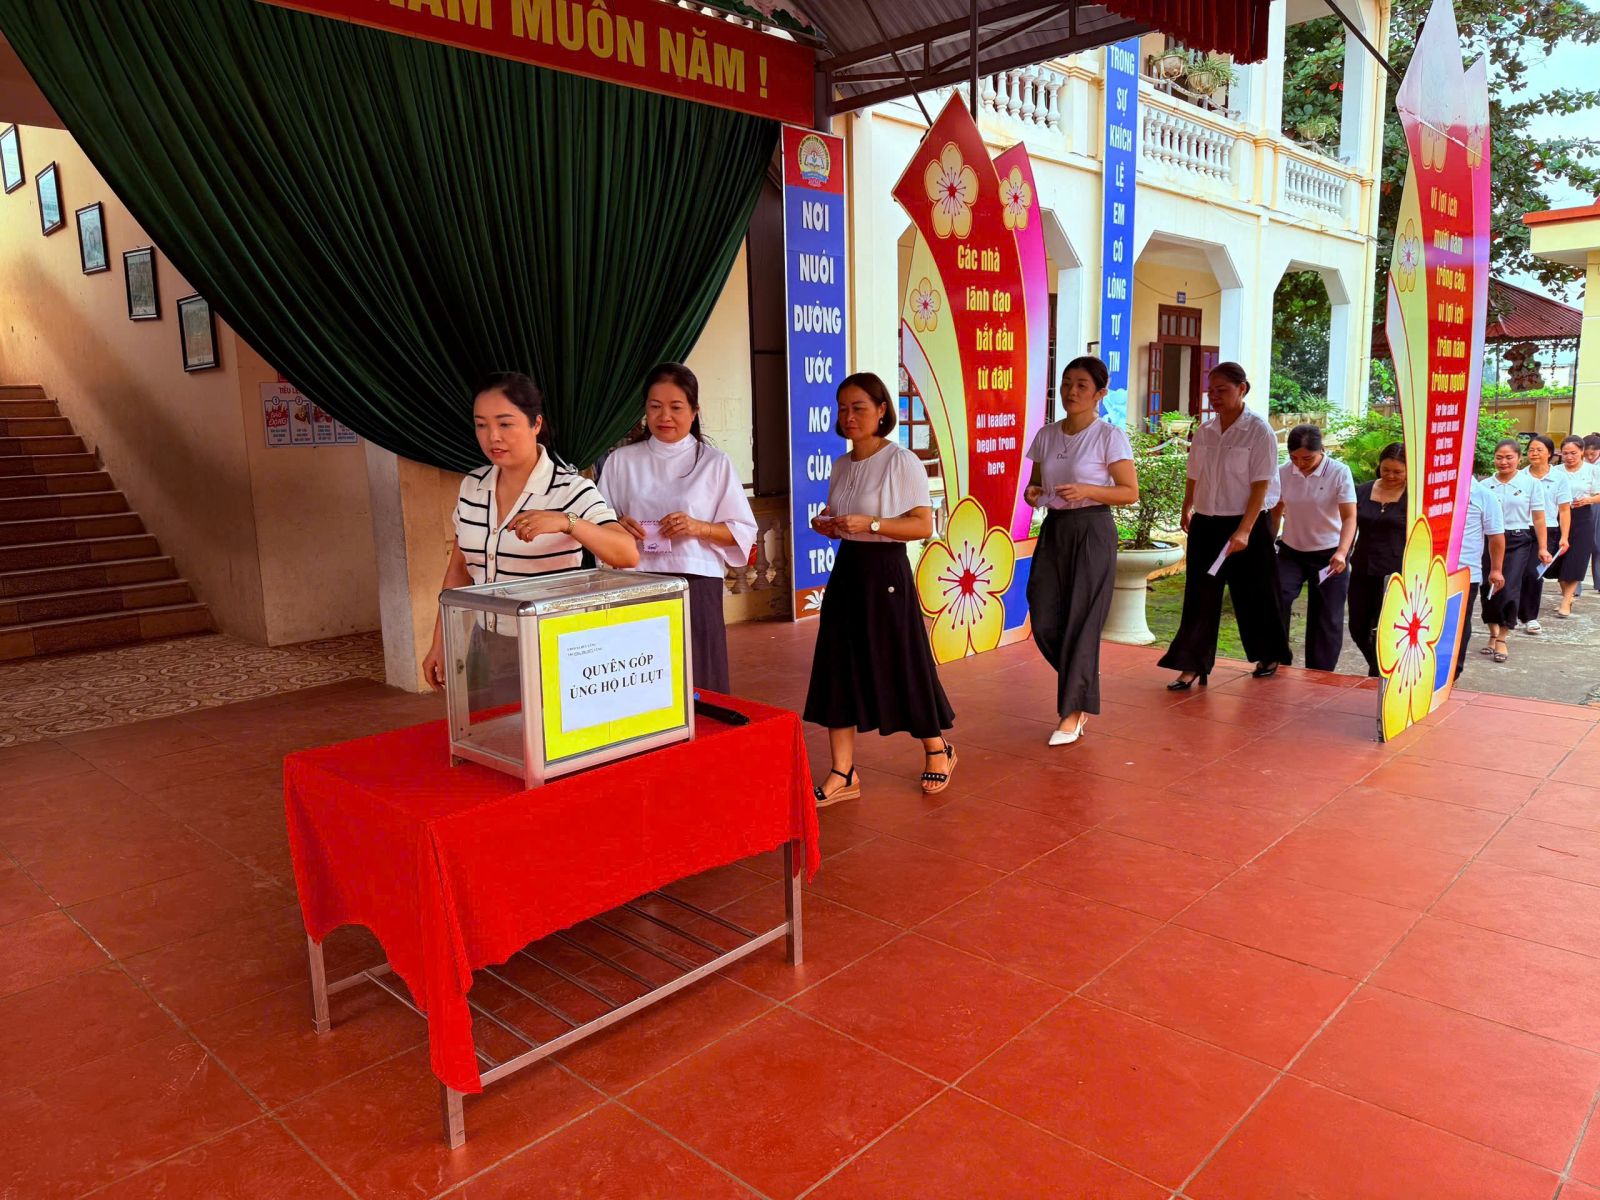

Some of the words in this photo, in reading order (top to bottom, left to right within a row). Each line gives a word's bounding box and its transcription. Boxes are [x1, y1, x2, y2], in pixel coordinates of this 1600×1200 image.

[511, 0, 645, 67] MUÔN
[659, 27, 745, 93] NĂM
[1110, 44, 1135, 76] TRONG
[1116, 87, 1128, 117] SỰ
[1109, 122, 1132, 152] KHÍCH
[1115, 161, 1124, 193] LỆ
[802, 200, 829, 232] NƠI
[1113, 202, 1125, 226] EM
[957, 244, 978, 270] Các
[981, 246, 1000, 272] nhà
[1112, 236, 1123, 263] CÓ
[1107, 272, 1126, 300] LÒNG
[966, 286, 989, 311] lãnh
[992, 289, 1011, 318] đạo
[976, 322, 993, 351] bắt
[996, 322, 1014, 351] đầu
[1111, 313, 1121, 340] TỰ
[804, 350, 832, 384] ƯỚC
[1109, 351, 1120, 373] TIN
[977, 365, 988, 391] từ
[991, 365, 1013, 391] đây!
[808, 406, 831, 433] MƠ
[976, 414, 986, 429] All
[987, 413, 1015, 428] leaders
[976, 437, 996, 453] begin
[998, 436, 1016, 451] from
[807, 448, 832, 481] CỦA
[987, 461, 1005, 476] here
[809, 540, 835, 575] TRÒ
[582, 658, 626, 680] QUYÊN
[629, 652, 654, 669] GÓP
[601, 677, 619, 693] HỘ
[622, 672, 637, 688] LŨ
[640, 669, 664, 684] LỤT
